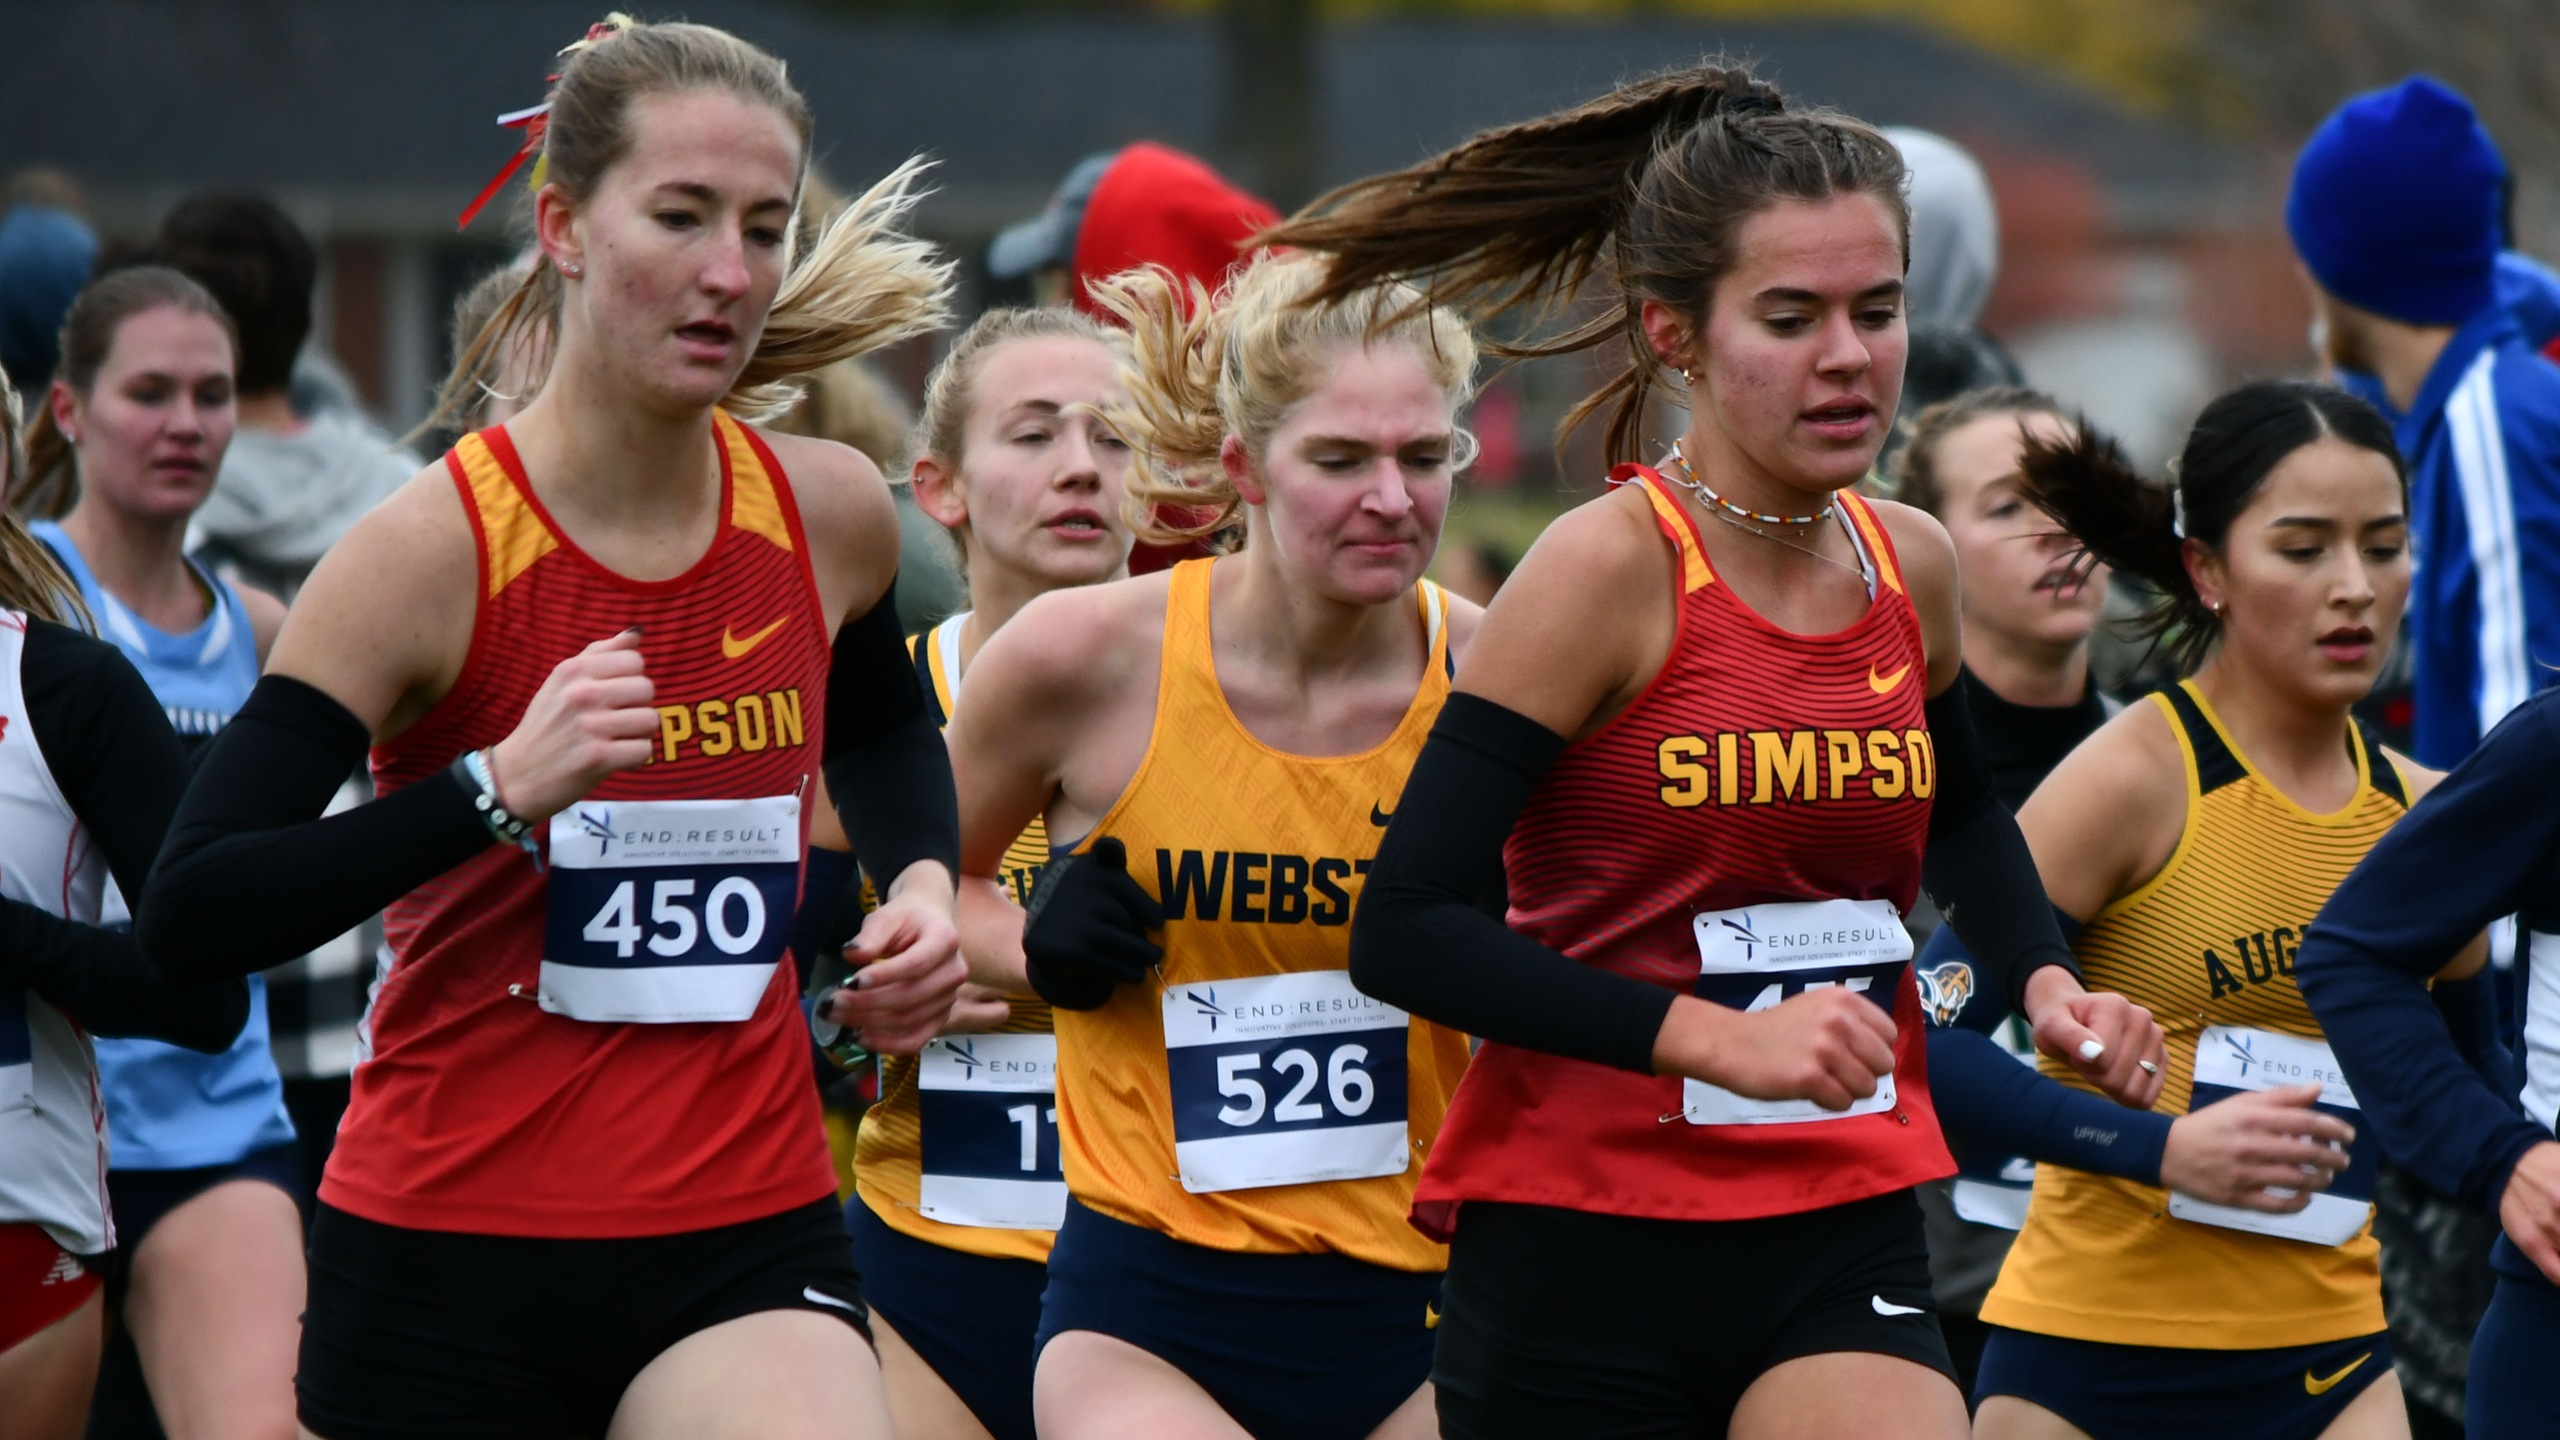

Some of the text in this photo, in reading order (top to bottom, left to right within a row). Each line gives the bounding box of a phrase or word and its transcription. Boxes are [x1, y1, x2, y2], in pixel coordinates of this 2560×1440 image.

[645, 689, 804, 764] PSON
[1659, 729, 1936, 807] SIMPSO
[624, 828, 781, 844] END:RESULT
[583, 876, 766, 957] 450
[1769, 928, 1895, 947] END:RESULT
[2203, 924, 2310, 999] AUG
[990, 1061, 1056, 1073] END:
[1217, 1043, 1374, 1127] 526
